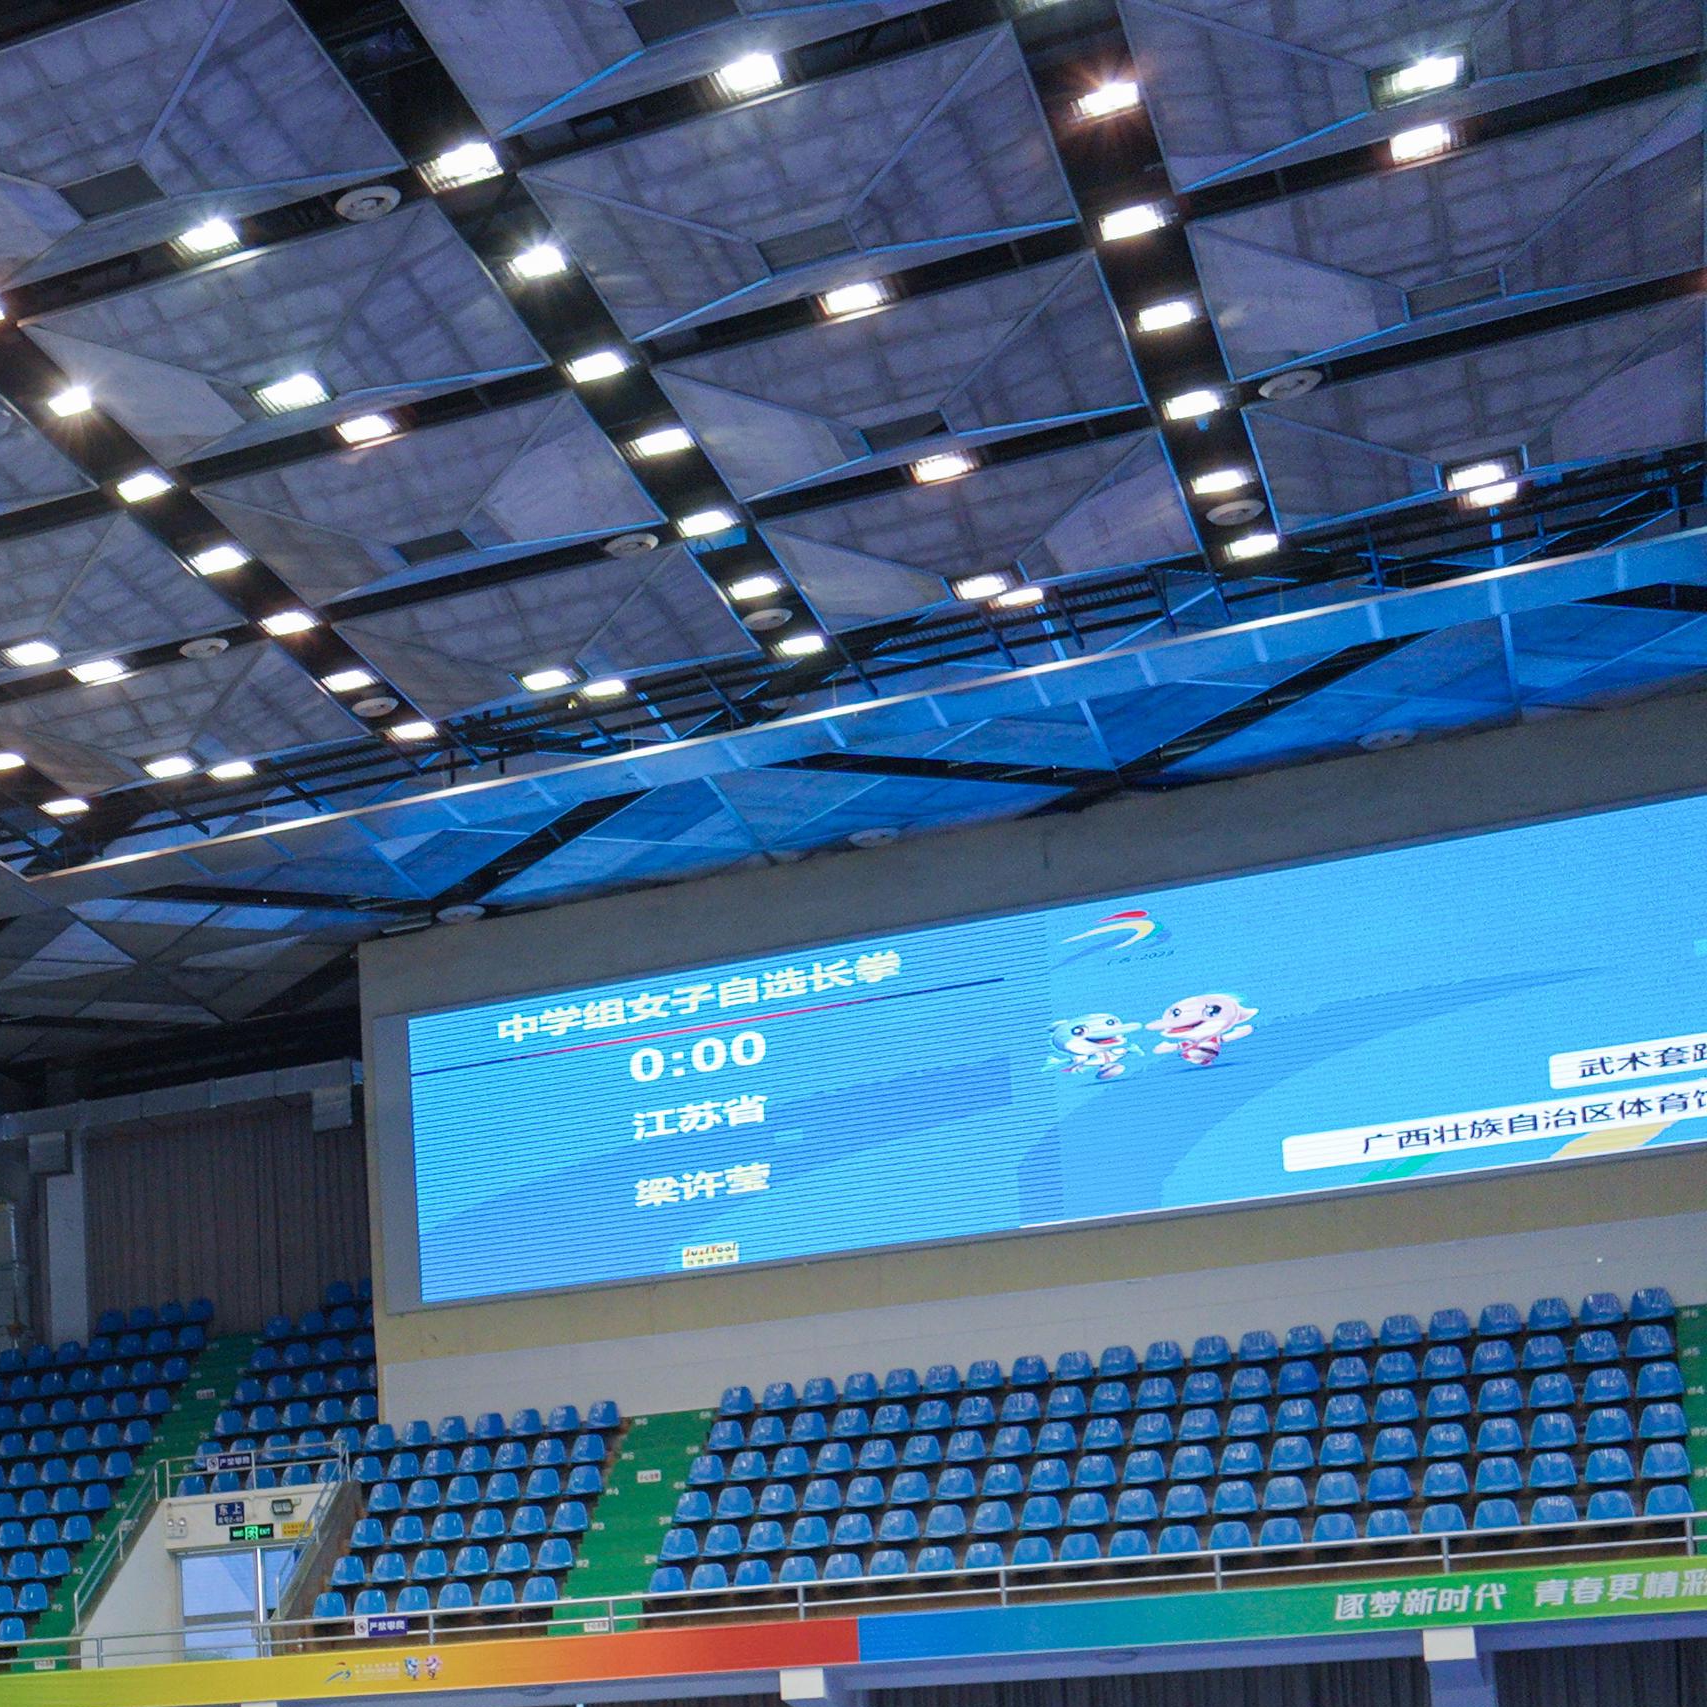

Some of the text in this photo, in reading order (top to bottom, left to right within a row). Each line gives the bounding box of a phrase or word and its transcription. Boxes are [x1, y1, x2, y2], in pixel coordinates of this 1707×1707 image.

[498, 951, 901, 1043] 中学组女子自选长拳
[630, 1031, 766, 1083] 0:00
[633, 1095, 768, 1140] 江苏省
[1334, 1568, 1707, 1620] 逐梦新时代 青春更精彩
